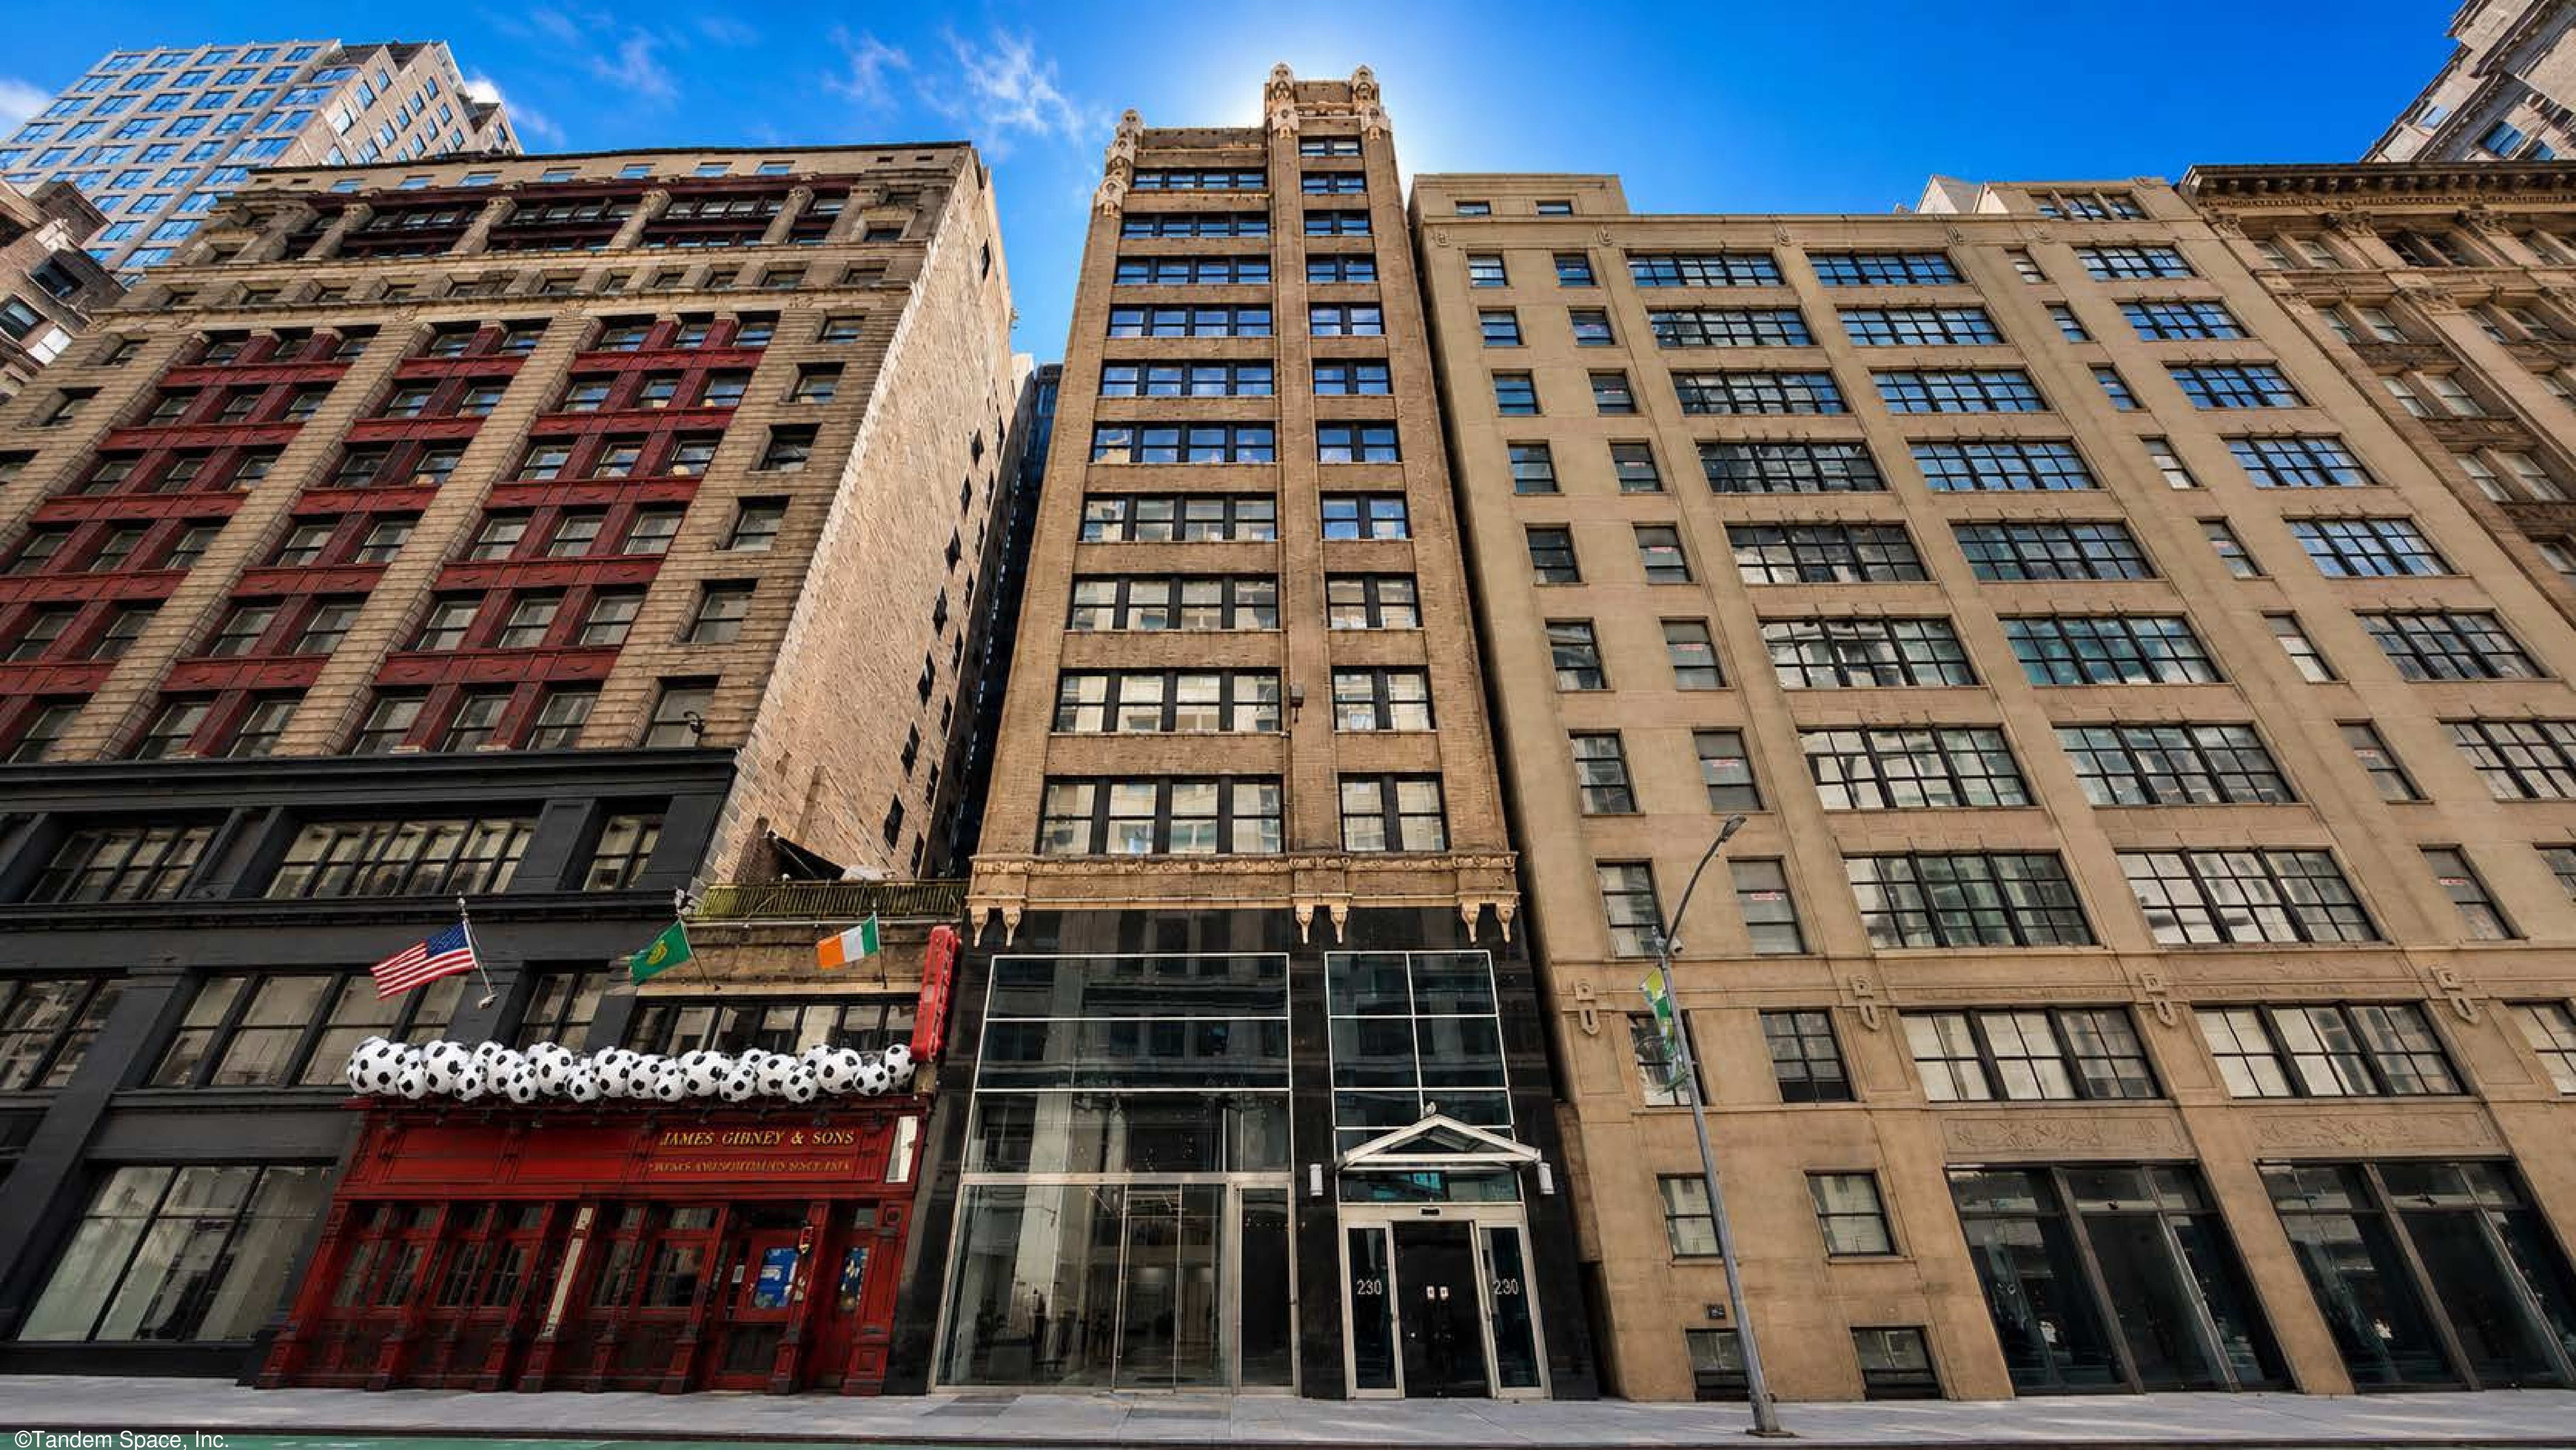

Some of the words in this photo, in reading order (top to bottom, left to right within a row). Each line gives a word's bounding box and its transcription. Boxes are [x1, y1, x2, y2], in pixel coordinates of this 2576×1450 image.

[660, 1131, 715, 1146] JAMES
[791, 1130, 804, 1145] &
[812, 1130, 854, 1145] SONS
[1357, 1279, 1382, 1295] 230
[1492, 1279, 1519, 1295] 230
